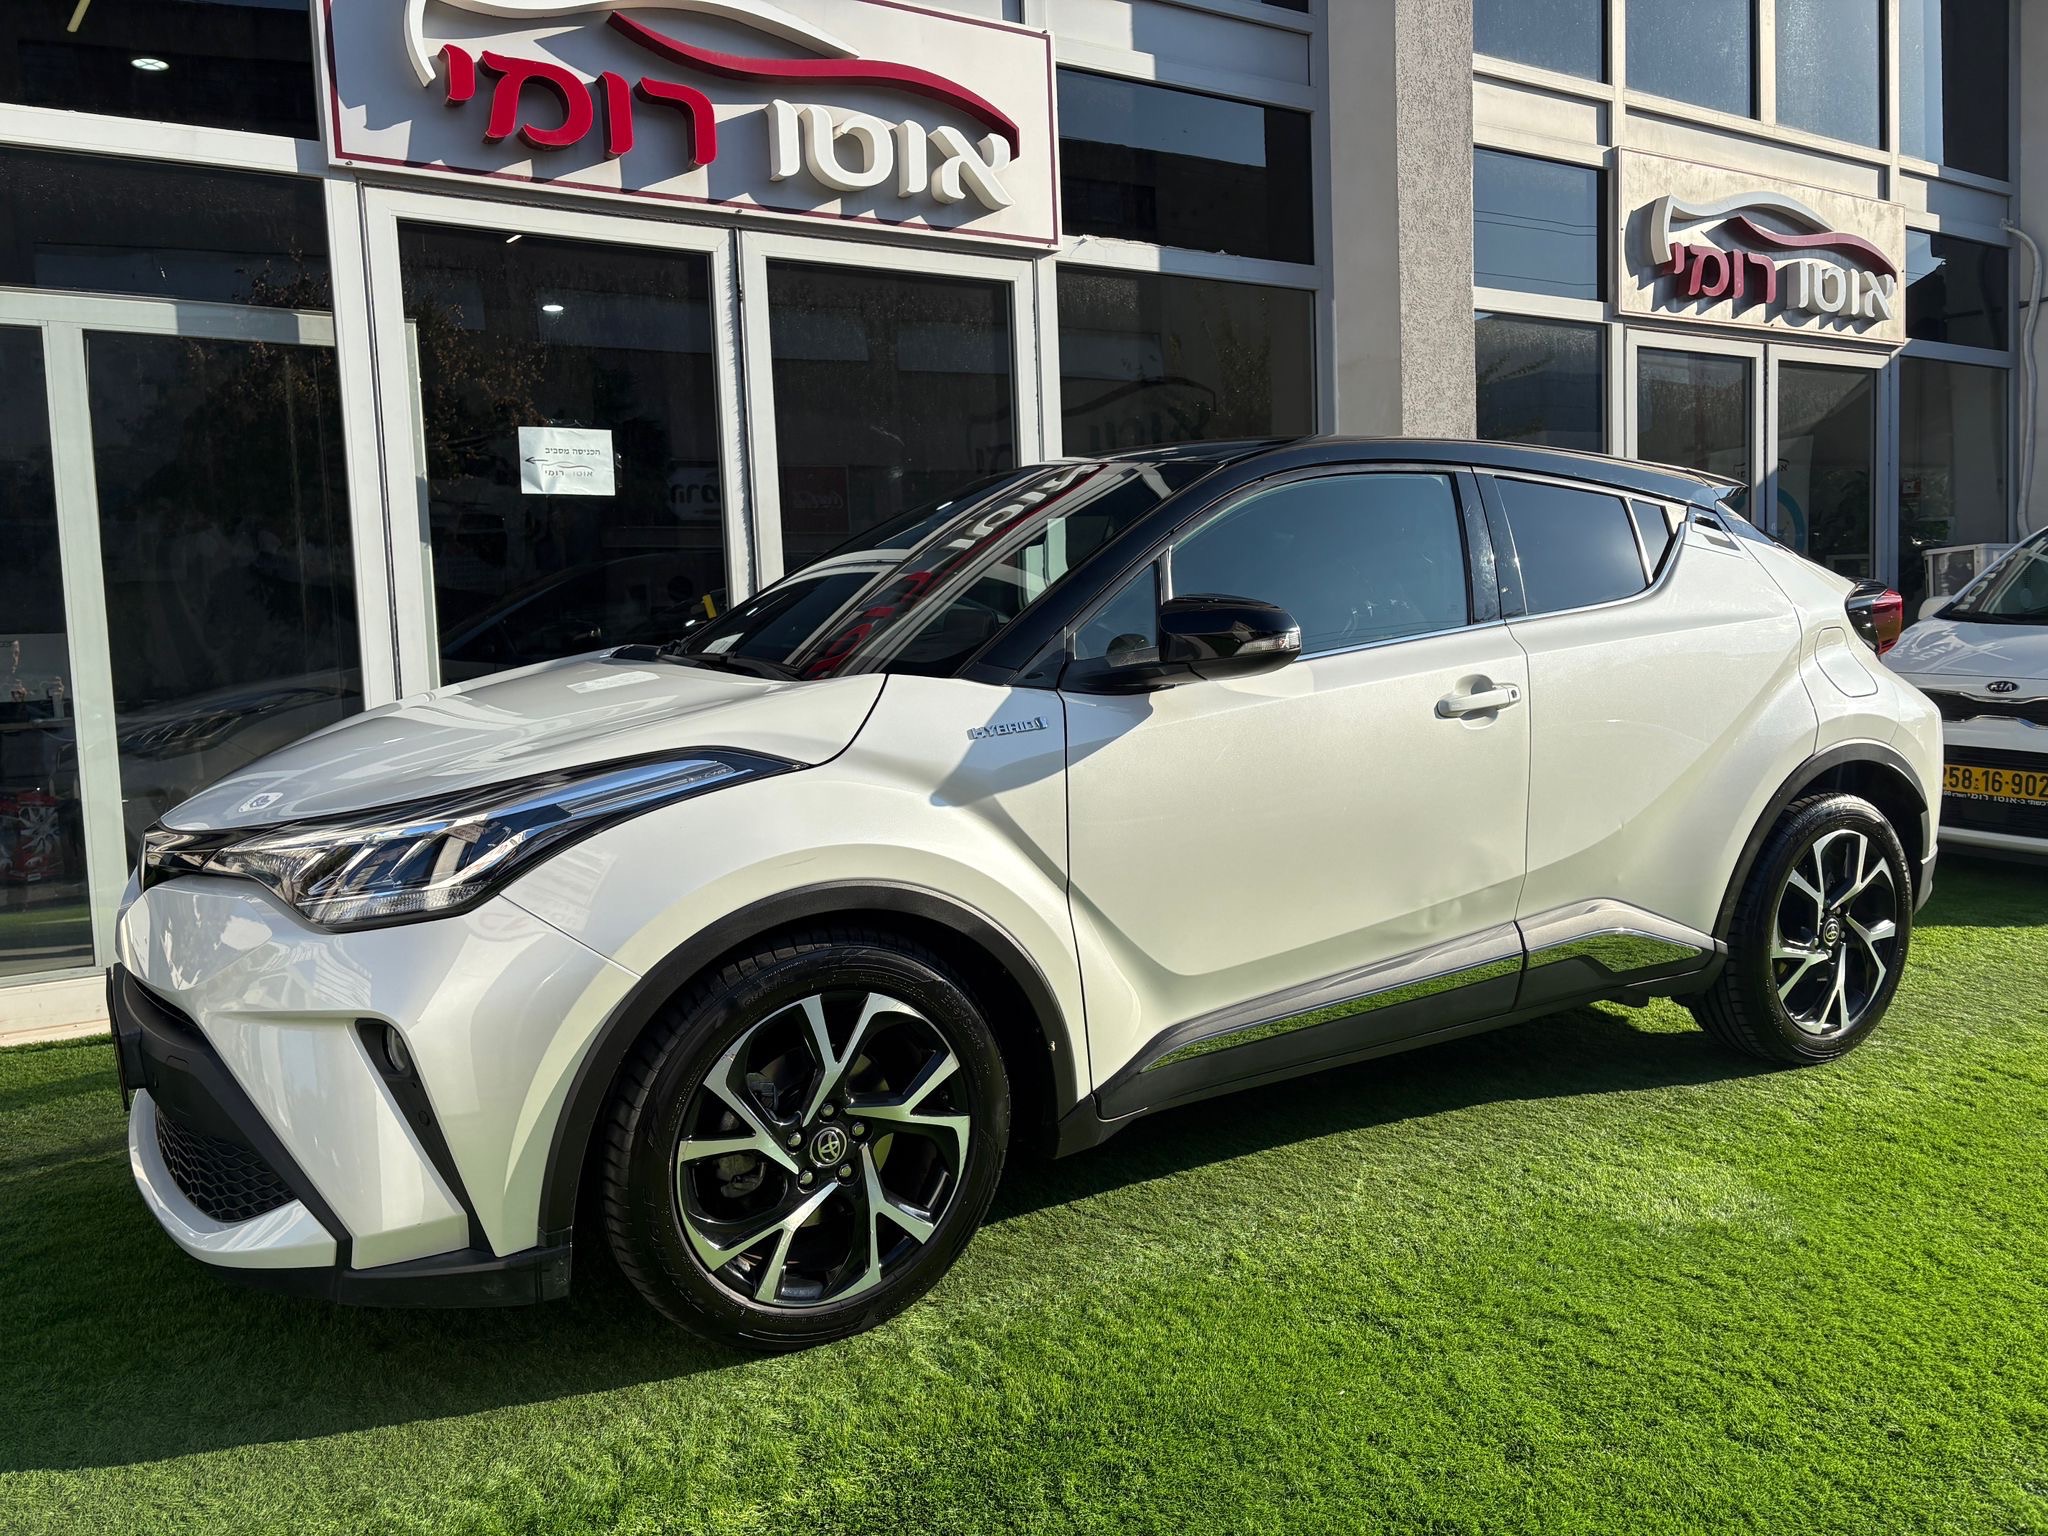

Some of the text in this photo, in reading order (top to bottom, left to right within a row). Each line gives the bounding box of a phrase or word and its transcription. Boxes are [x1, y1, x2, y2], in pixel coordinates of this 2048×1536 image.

[438, 43, 1014, 210] אוטו רומי
[1666, 240, 1897, 320] אוטו רומי
[544, 447, 601, 456] הכניסה מסביב
[544, 469, 565, 477] רומי
[967, 718, 1037, 741] HYBRID
